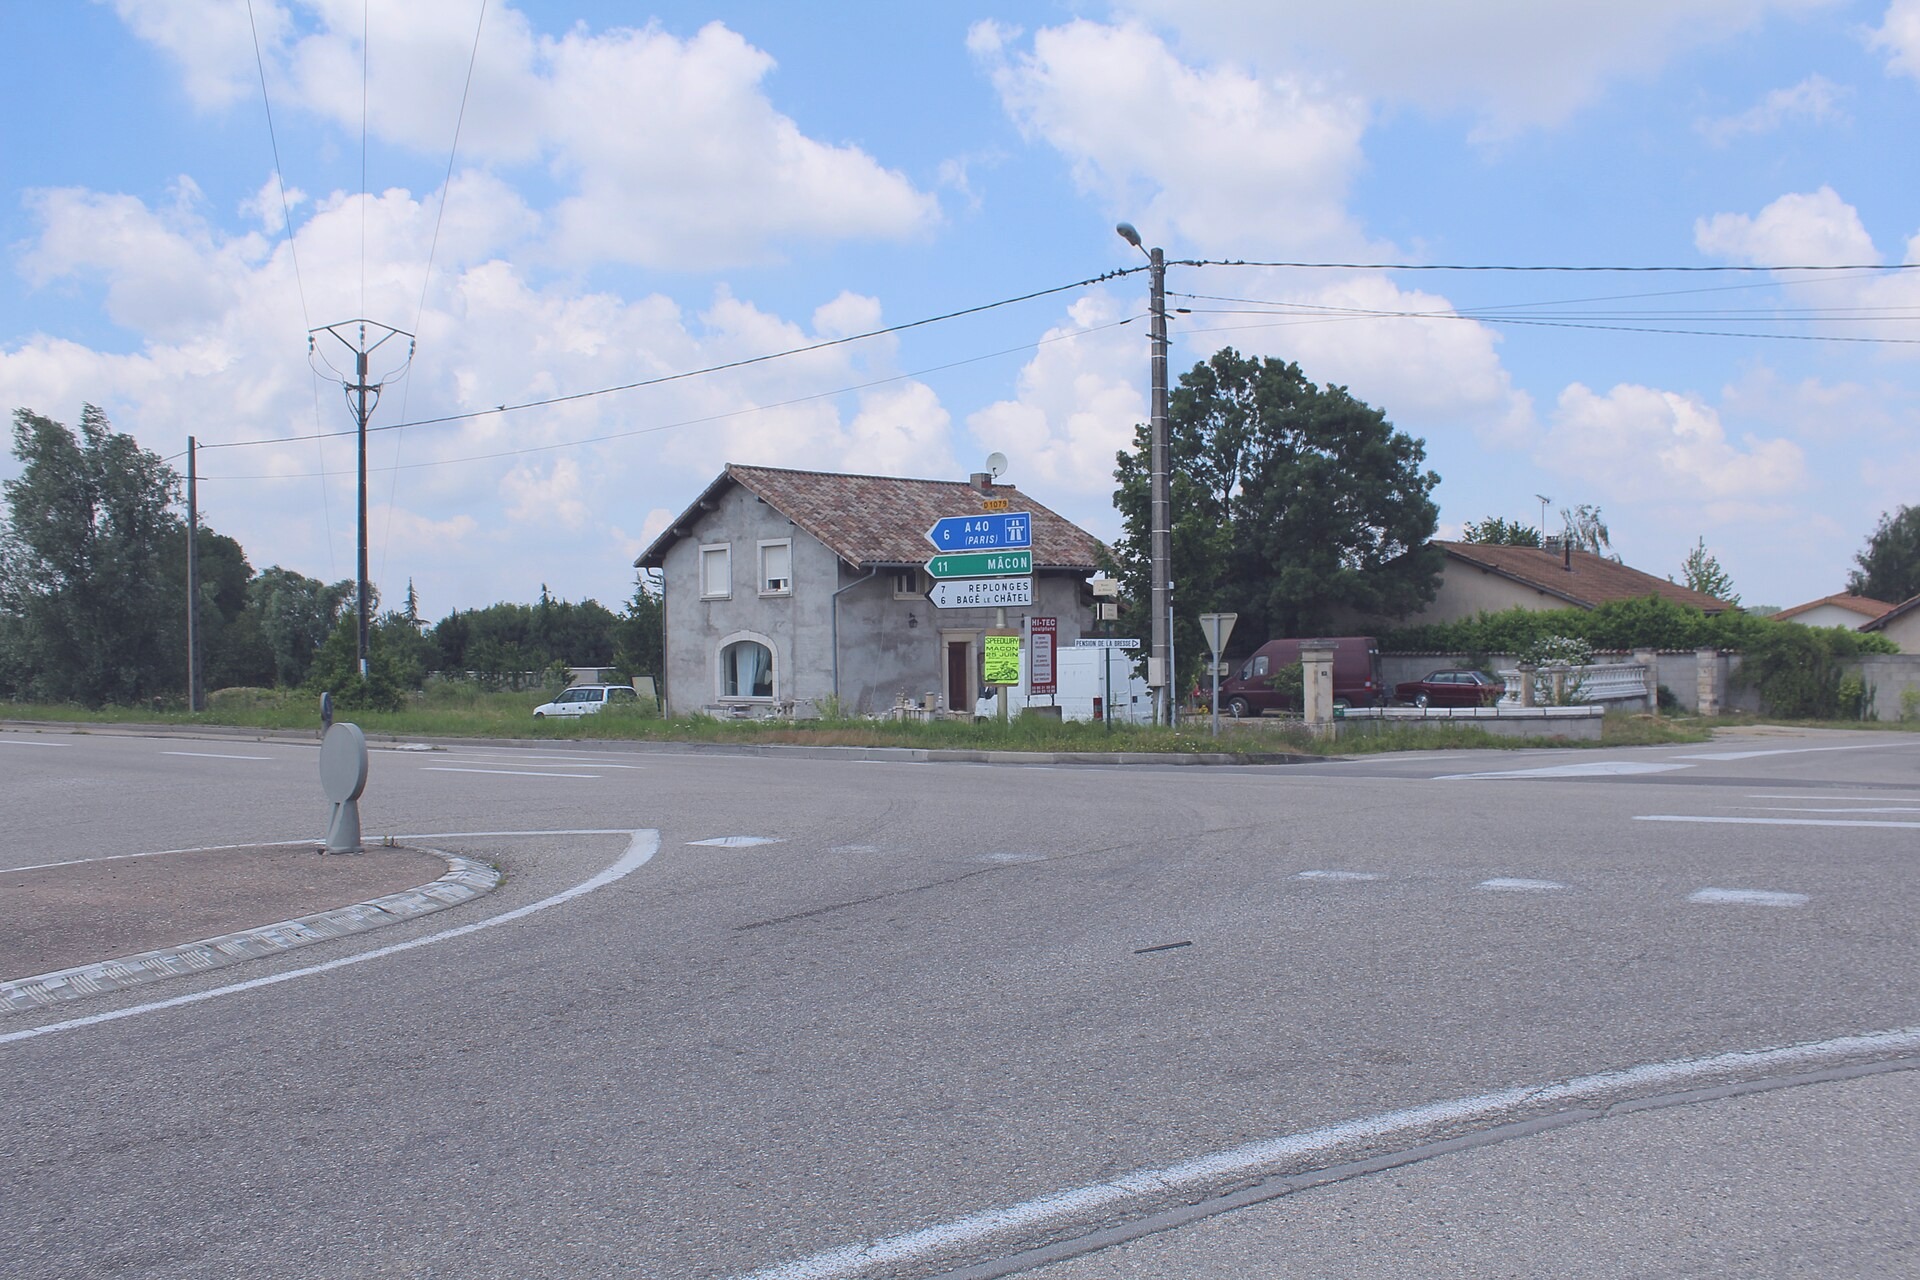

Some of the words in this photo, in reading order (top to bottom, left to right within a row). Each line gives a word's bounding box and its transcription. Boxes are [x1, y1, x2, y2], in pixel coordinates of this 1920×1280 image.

[965, 522, 971, 532] A
[975, 520, 989, 532] 40
[944, 530, 950, 540] 6
[965, 534, 998, 546] (PARIS)
[938, 562, 948, 572] 11
[988, 556, 1027, 570] MÂCON
[968, 582, 1028, 592] REPLONGES
[956, 594, 980, 604] BAGÉ
[994, 592, 1028, 602] CHÂTEL
